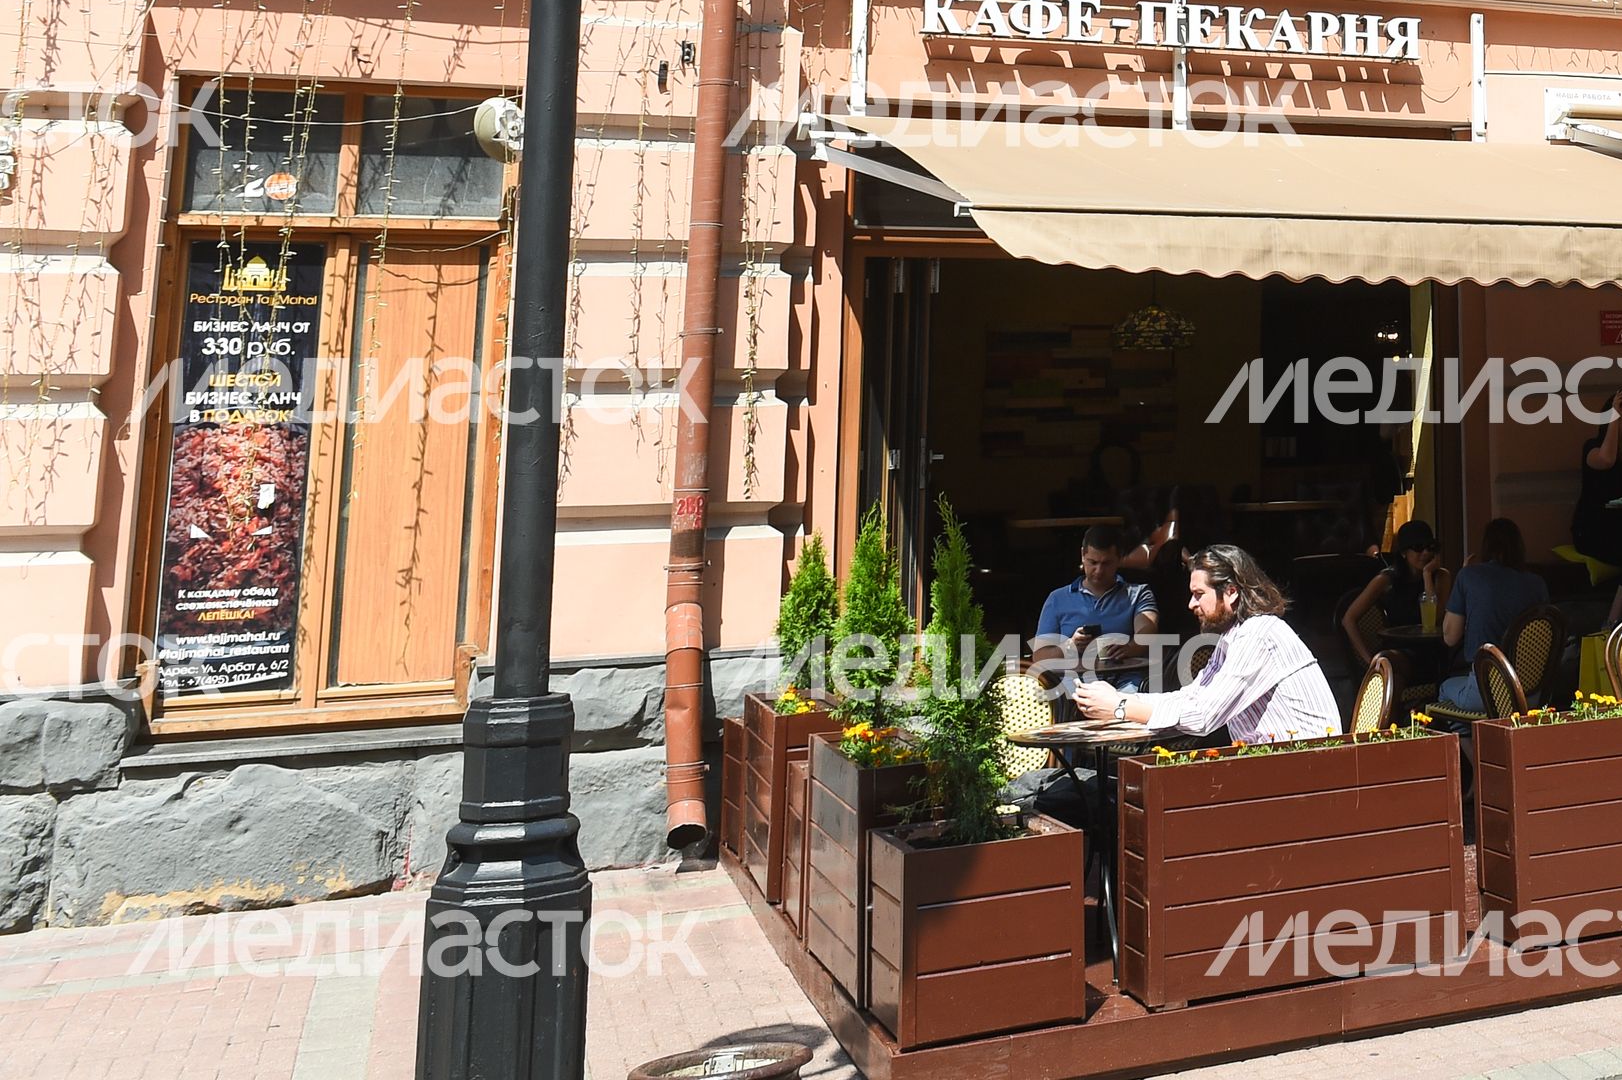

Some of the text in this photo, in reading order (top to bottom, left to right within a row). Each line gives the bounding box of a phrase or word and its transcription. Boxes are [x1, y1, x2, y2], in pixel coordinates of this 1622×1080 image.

[190, 293, 254, 306] Ресторан
[279, 294, 318, 306] Mahal
[193, 321, 249, 333] БИЗНЕС
[291, 321, 311, 333] ОТ
[201, 337, 297, 359] 330 руб.
[185, 391, 252, 406] БИЗНЕС
[188, 409, 201, 423] В
[177, 586, 279, 599] К каждому обеду
[218, 661, 257, 674] Арбат
[270, 659, 289, 670] 6/2
